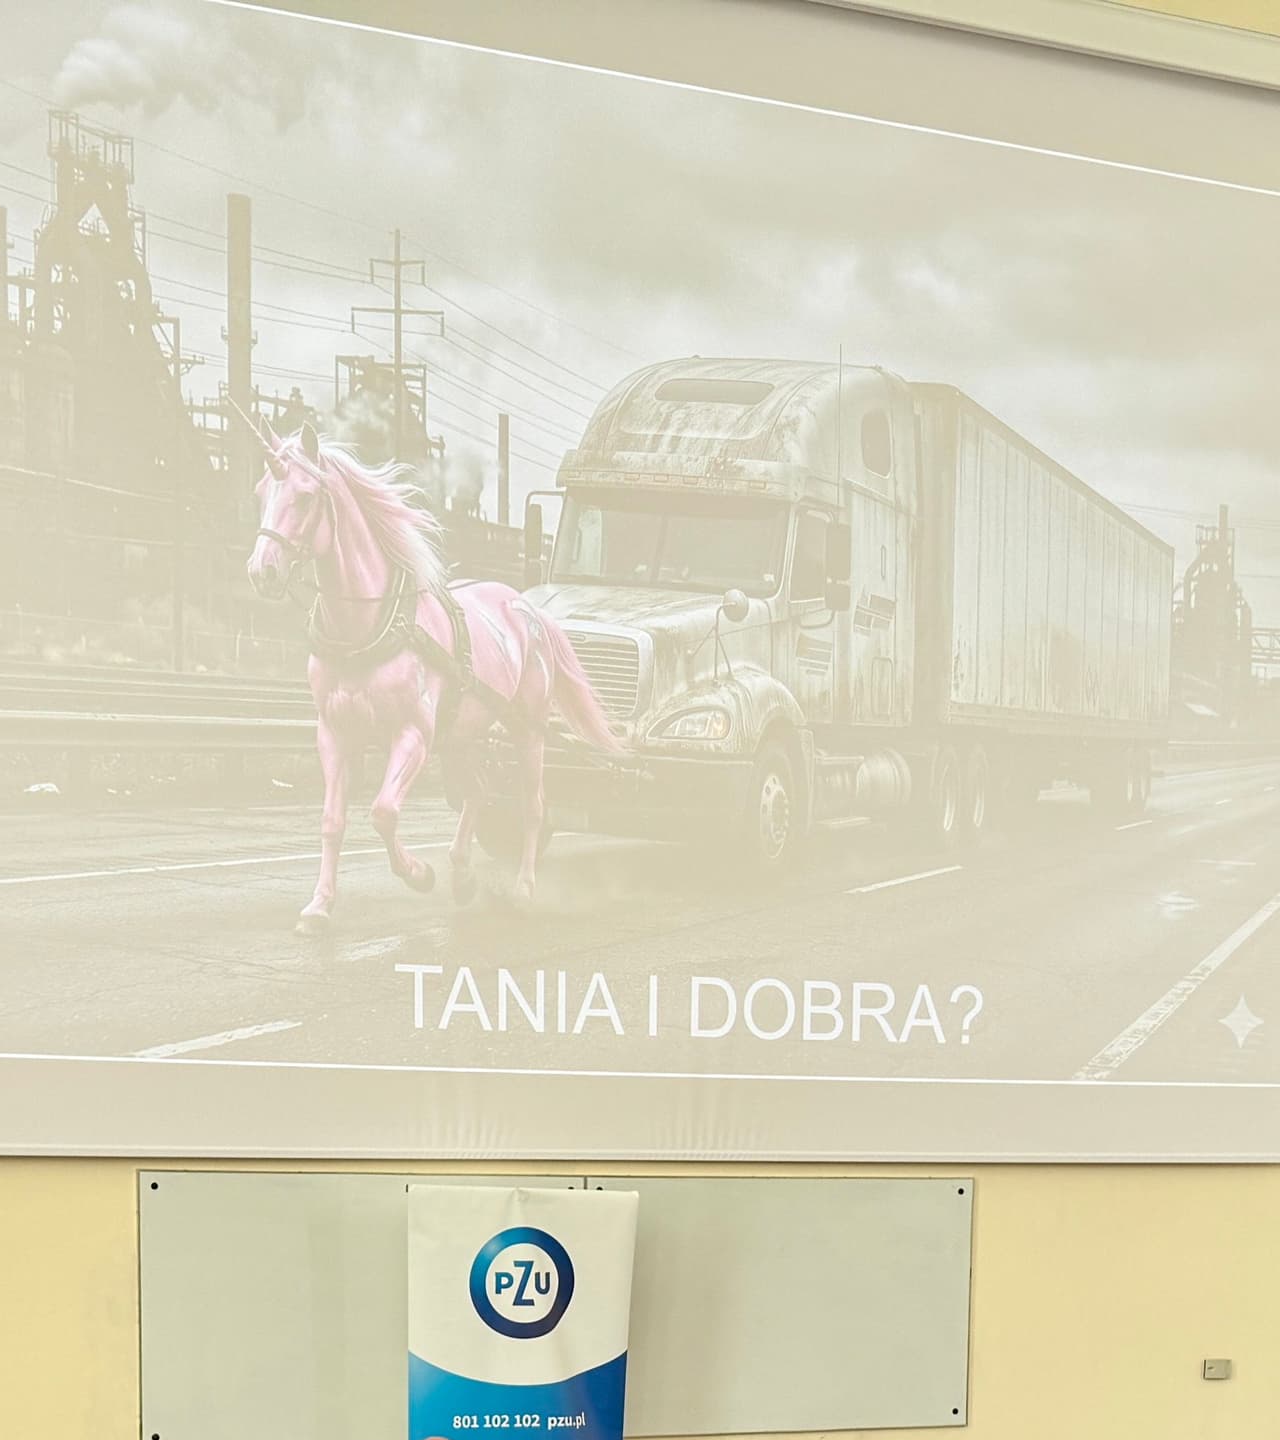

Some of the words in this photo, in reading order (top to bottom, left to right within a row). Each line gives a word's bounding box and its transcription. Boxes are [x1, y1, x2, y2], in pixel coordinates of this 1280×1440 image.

[395, 963, 624, 1036] TANIA
[649, 974, 658, 1037] I
[691, 975, 984, 1045] DOBRA?
[495, 1260, 551, 1306] PZU
[453, 1414, 479, 1429] 801
[483, 1414, 510, 1428] 102
[514, 1414, 540, 1428] 102
[547, 1412, 585, 1430] pzu.pl
